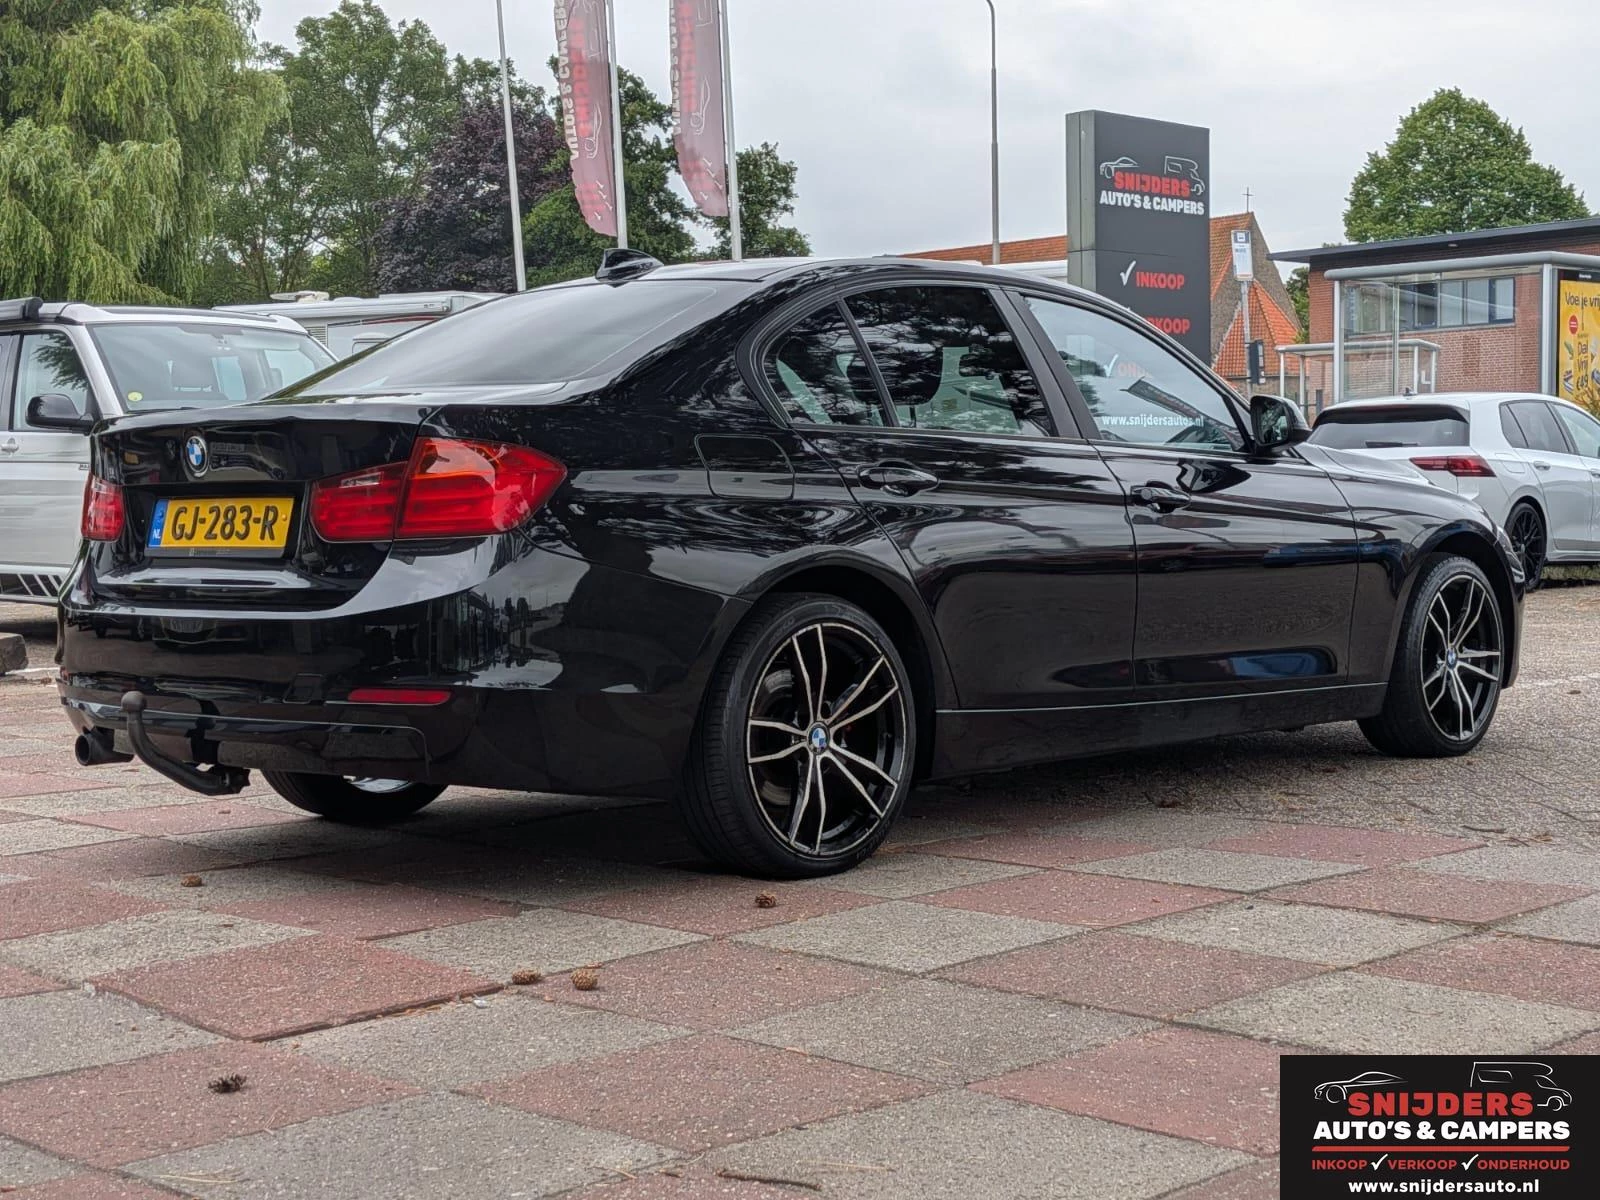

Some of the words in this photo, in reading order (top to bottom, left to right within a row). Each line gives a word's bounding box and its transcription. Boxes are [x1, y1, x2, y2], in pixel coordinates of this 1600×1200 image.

[1114, 171, 1191, 198] SNIJDERS
[1100, 190, 1141, 209] AUTO'S
[1143, 196, 1152, 210] &
[1153, 196, 1205, 215] CAMPERS
[1136, 271, 1185, 290] INKOOP
[171, 504, 279, 541] GJ-283-R
